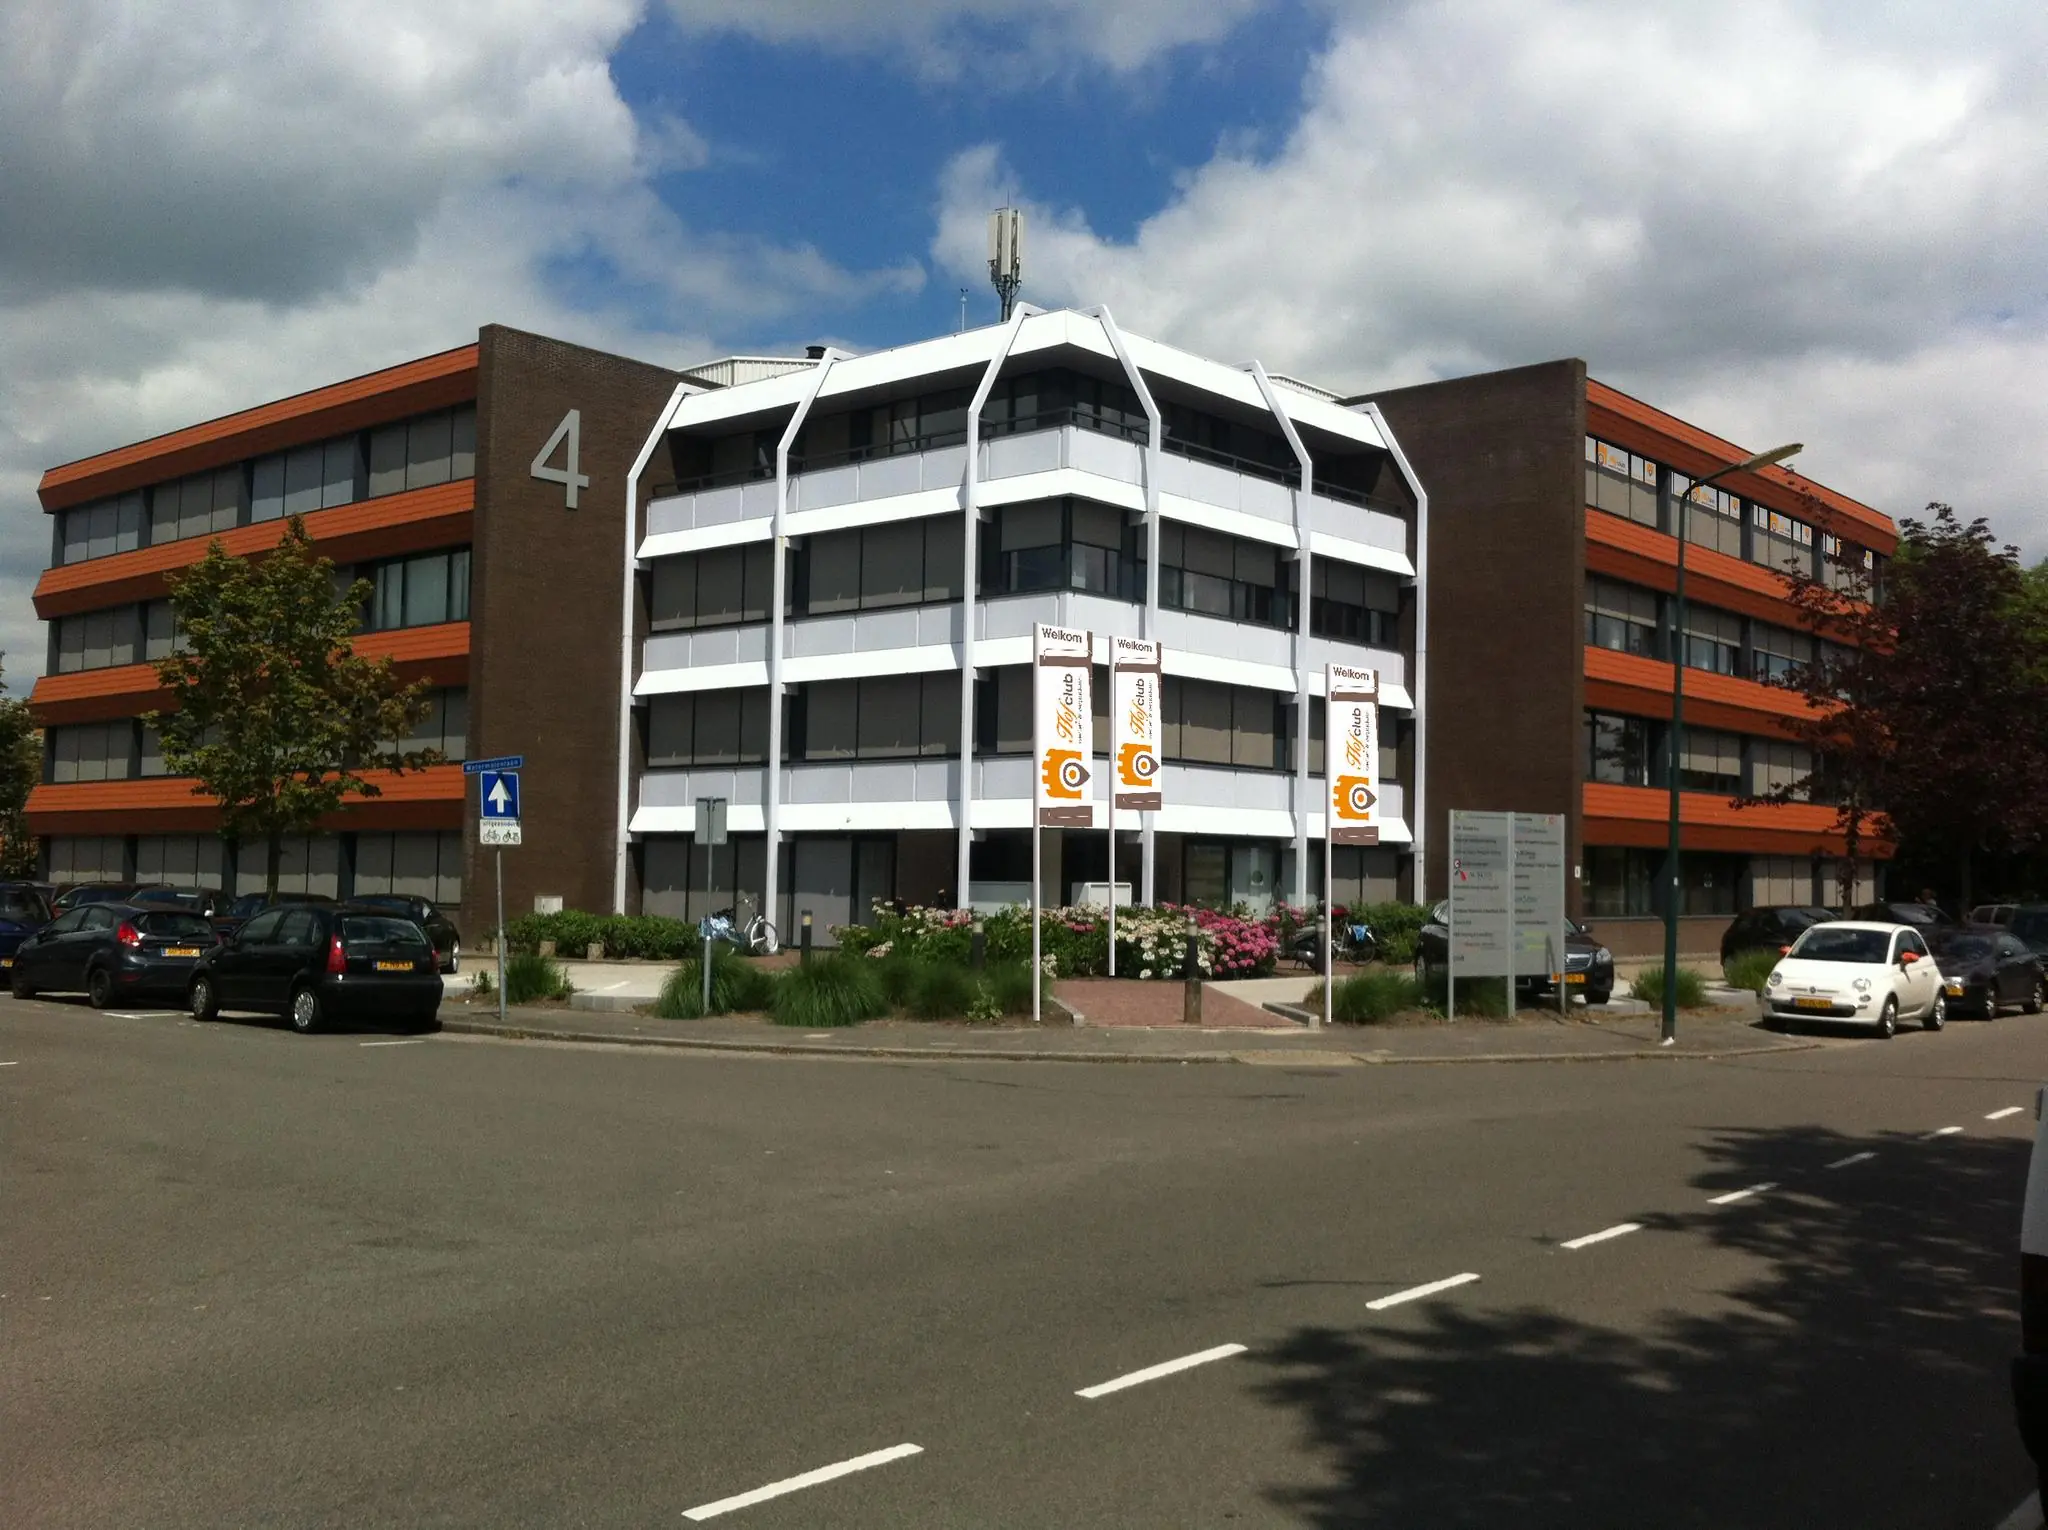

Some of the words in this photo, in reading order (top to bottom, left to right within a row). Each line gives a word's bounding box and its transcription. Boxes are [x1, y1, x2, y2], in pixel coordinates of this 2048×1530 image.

[530, 408, 589, 510] 4
[1042, 627, 1082, 643] Welkom
[1117, 638, 1153, 652] Welkom
[1333, 666, 1370, 681] Welkom
